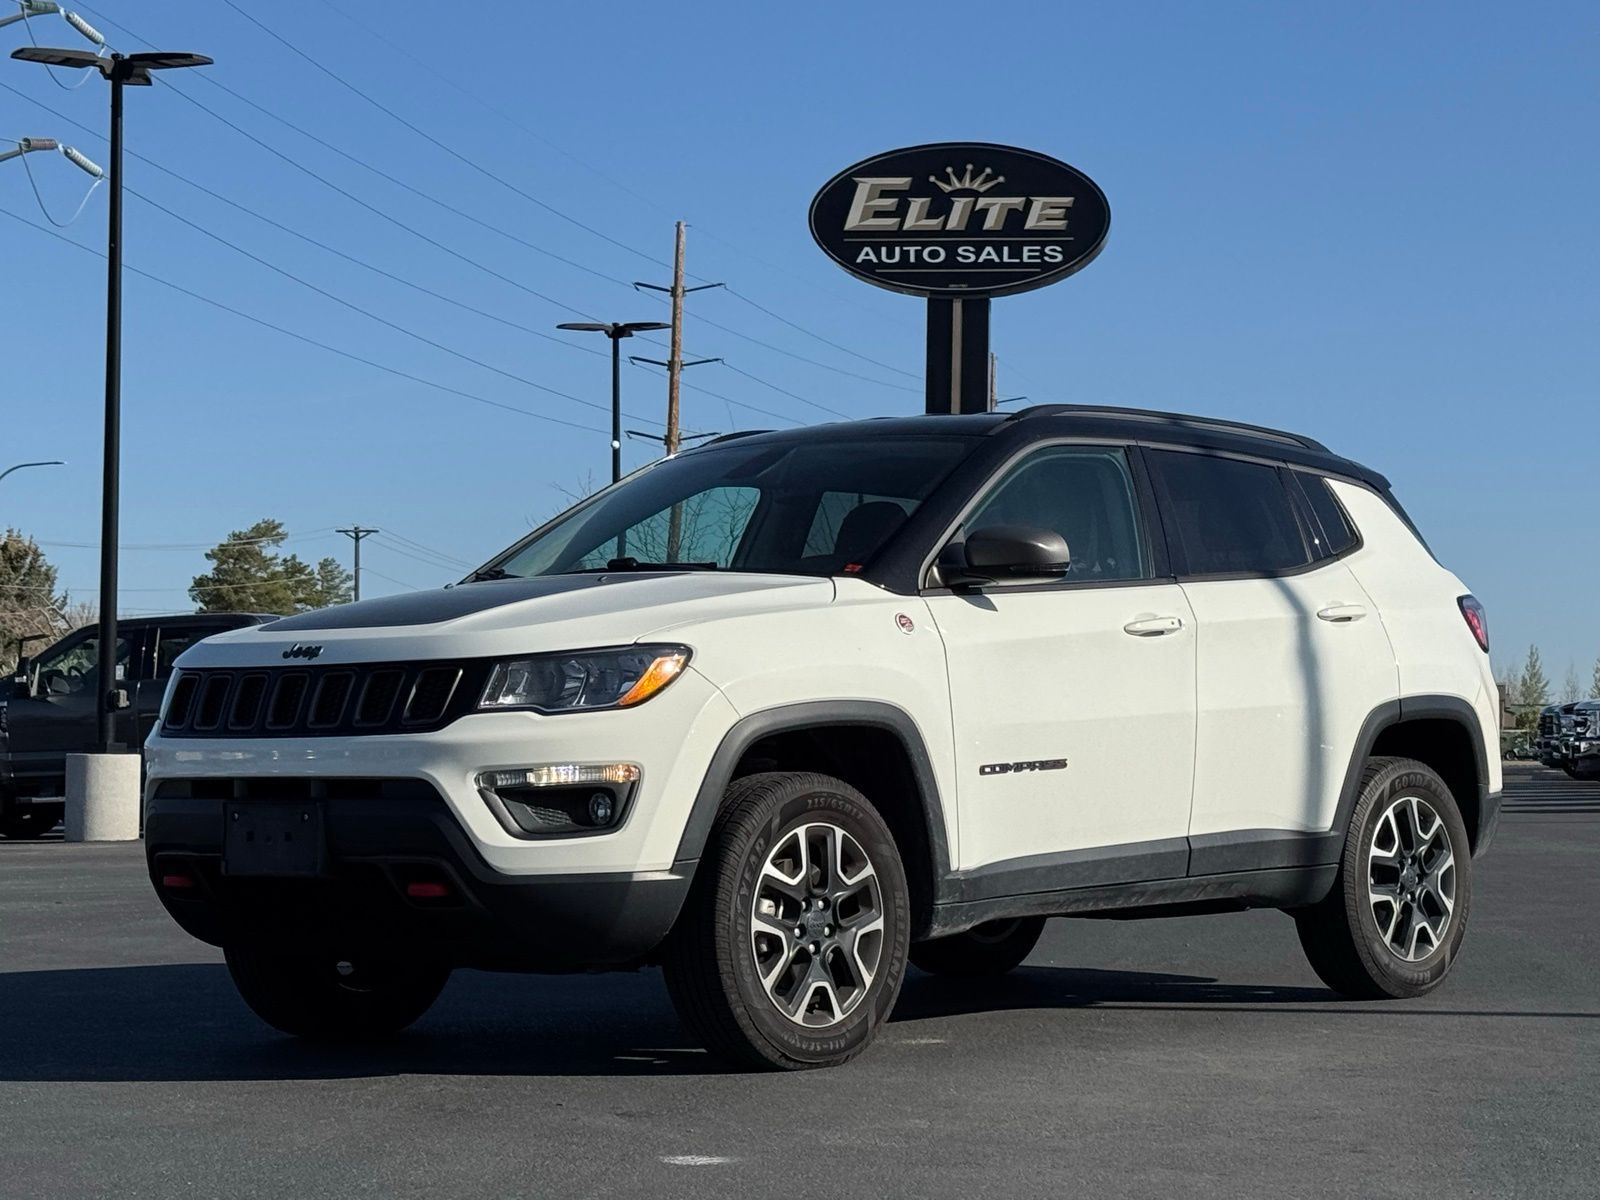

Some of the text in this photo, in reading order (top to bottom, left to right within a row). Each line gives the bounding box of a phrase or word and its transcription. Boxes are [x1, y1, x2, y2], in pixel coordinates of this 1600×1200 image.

[843, 177, 1075, 231] ELITE
[856, 245, 1063, 263] AUTO SALES
[282, 643, 322, 661] Jeep
